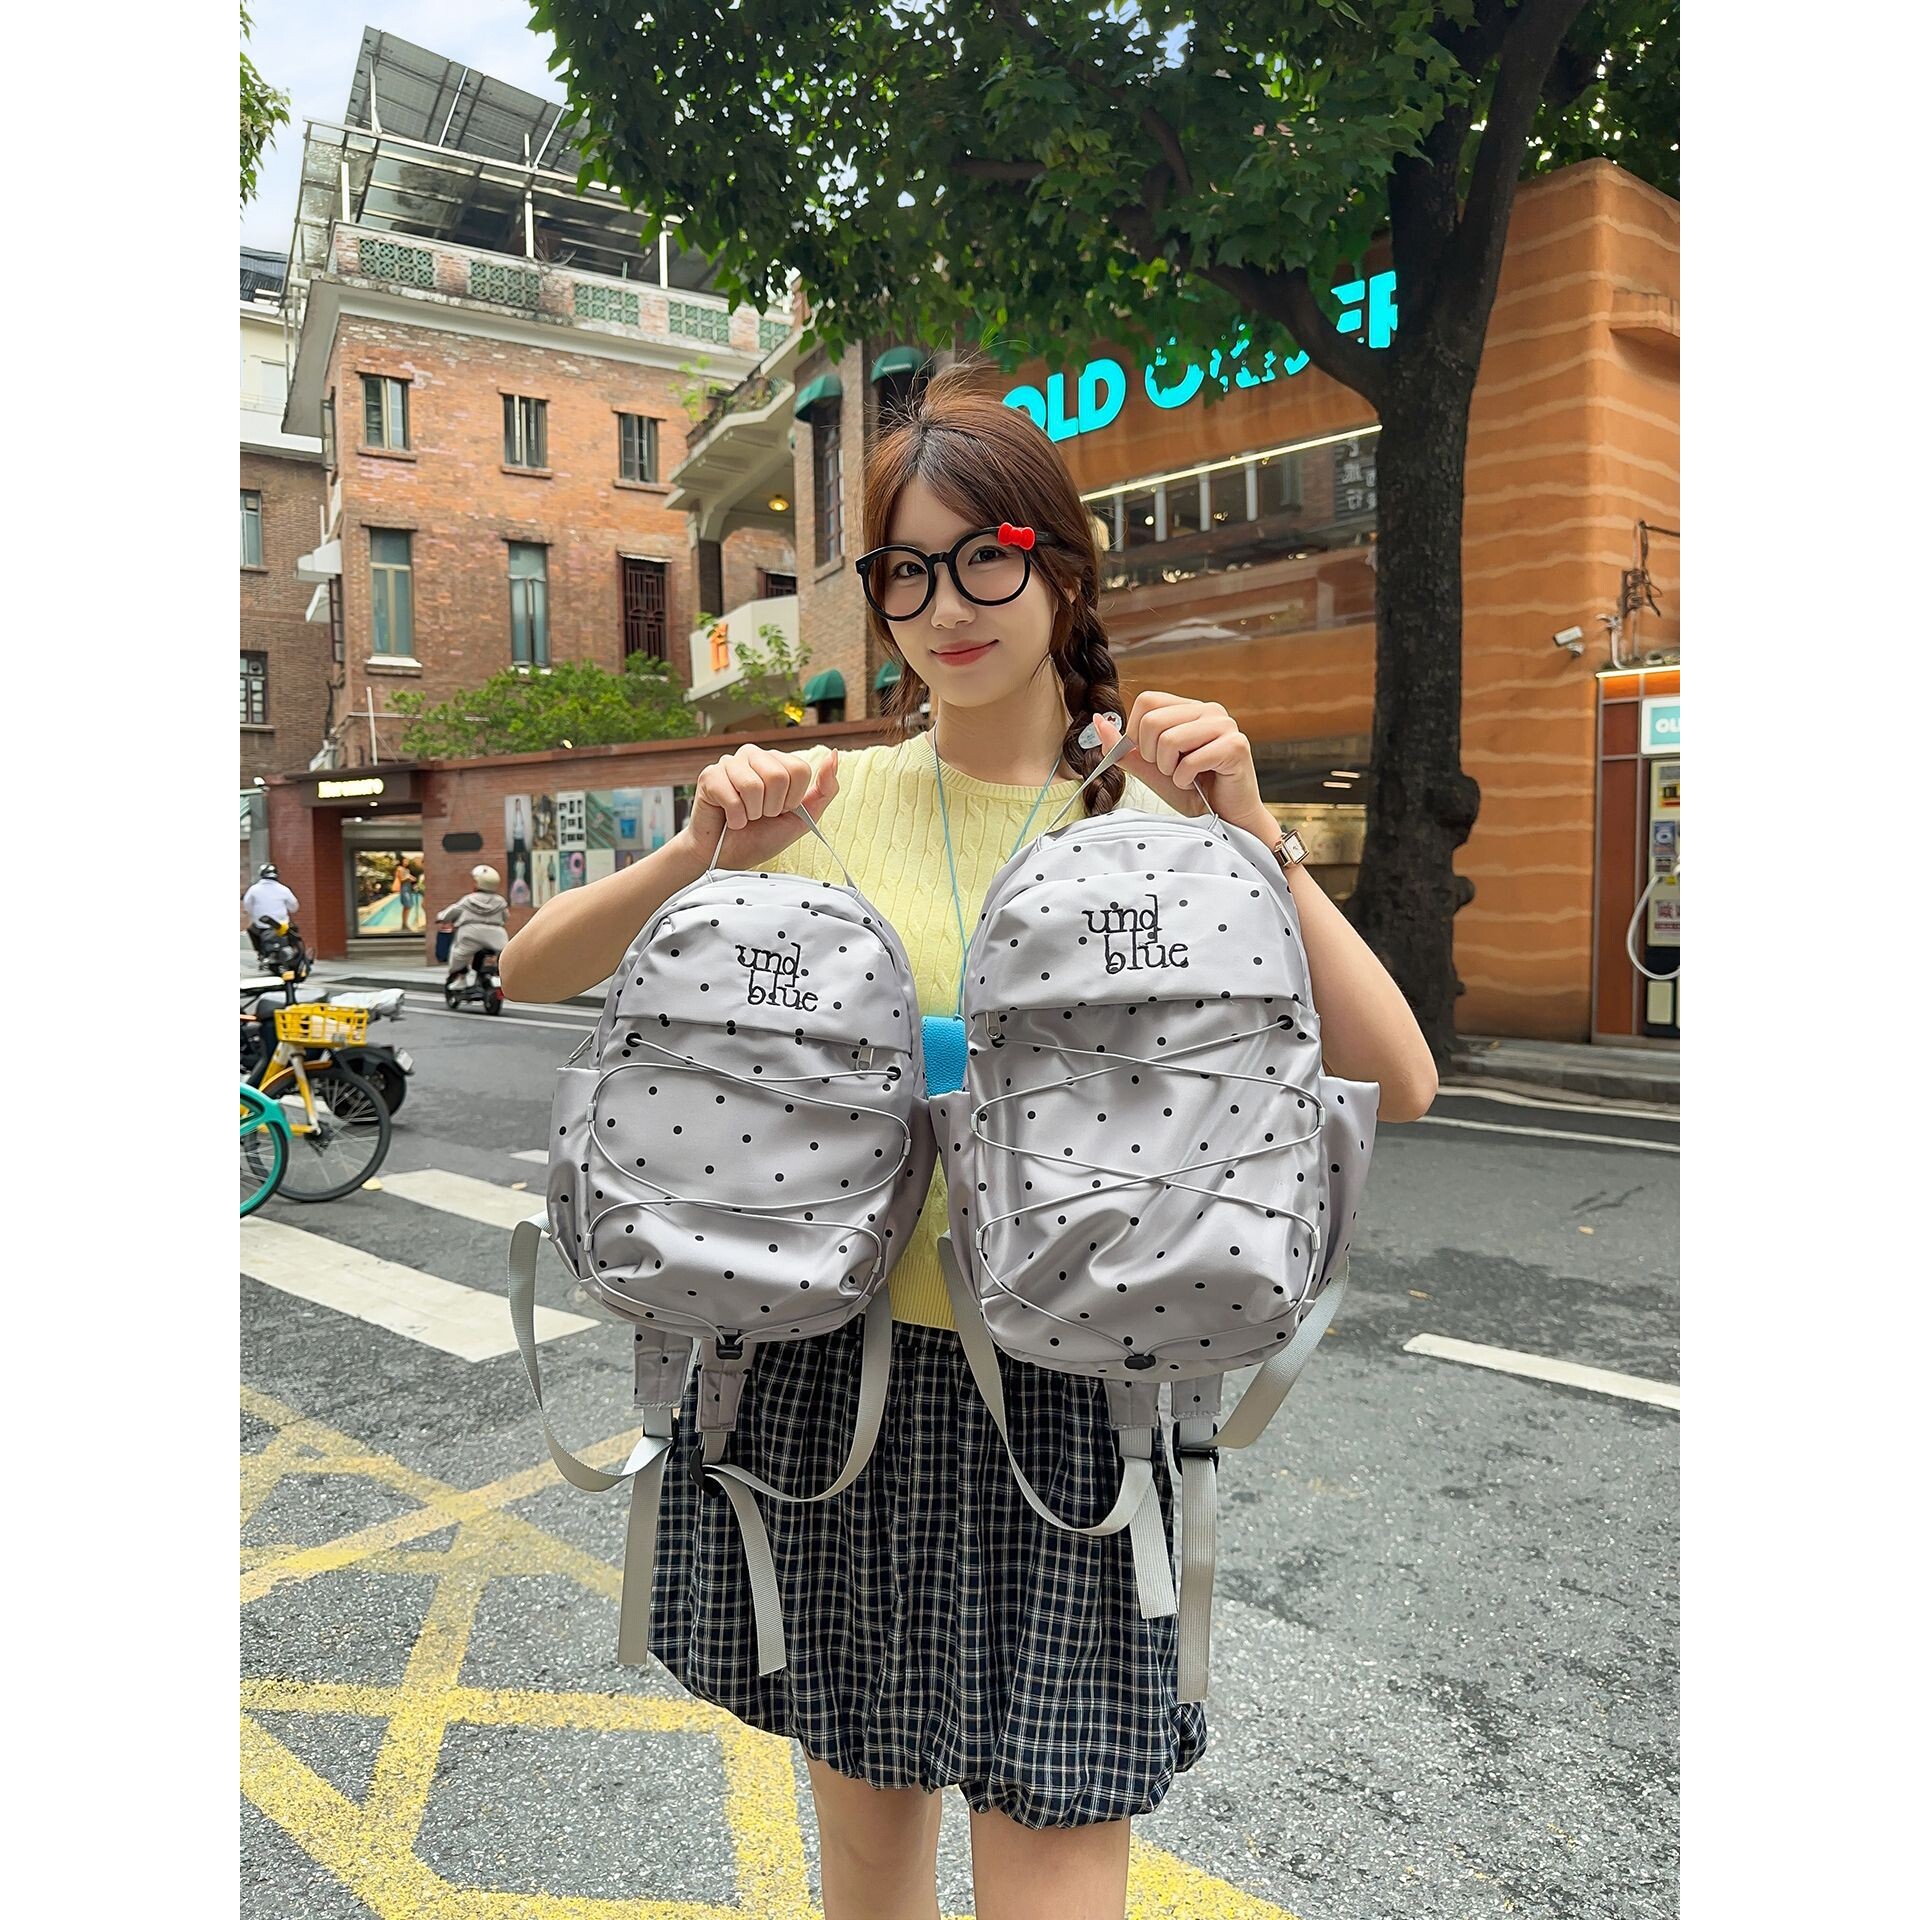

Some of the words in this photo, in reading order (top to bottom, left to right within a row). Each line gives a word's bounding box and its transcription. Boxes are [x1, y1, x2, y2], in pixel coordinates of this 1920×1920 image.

[1002, 359, 1126, 442] OLD
[1655, 717, 1680, 733] OL
[1081, 894, 1163, 943] und
[735, 942, 800, 987] und
[1103, 934, 1189, 974] blue
[748, 968, 818, 1011] blue
